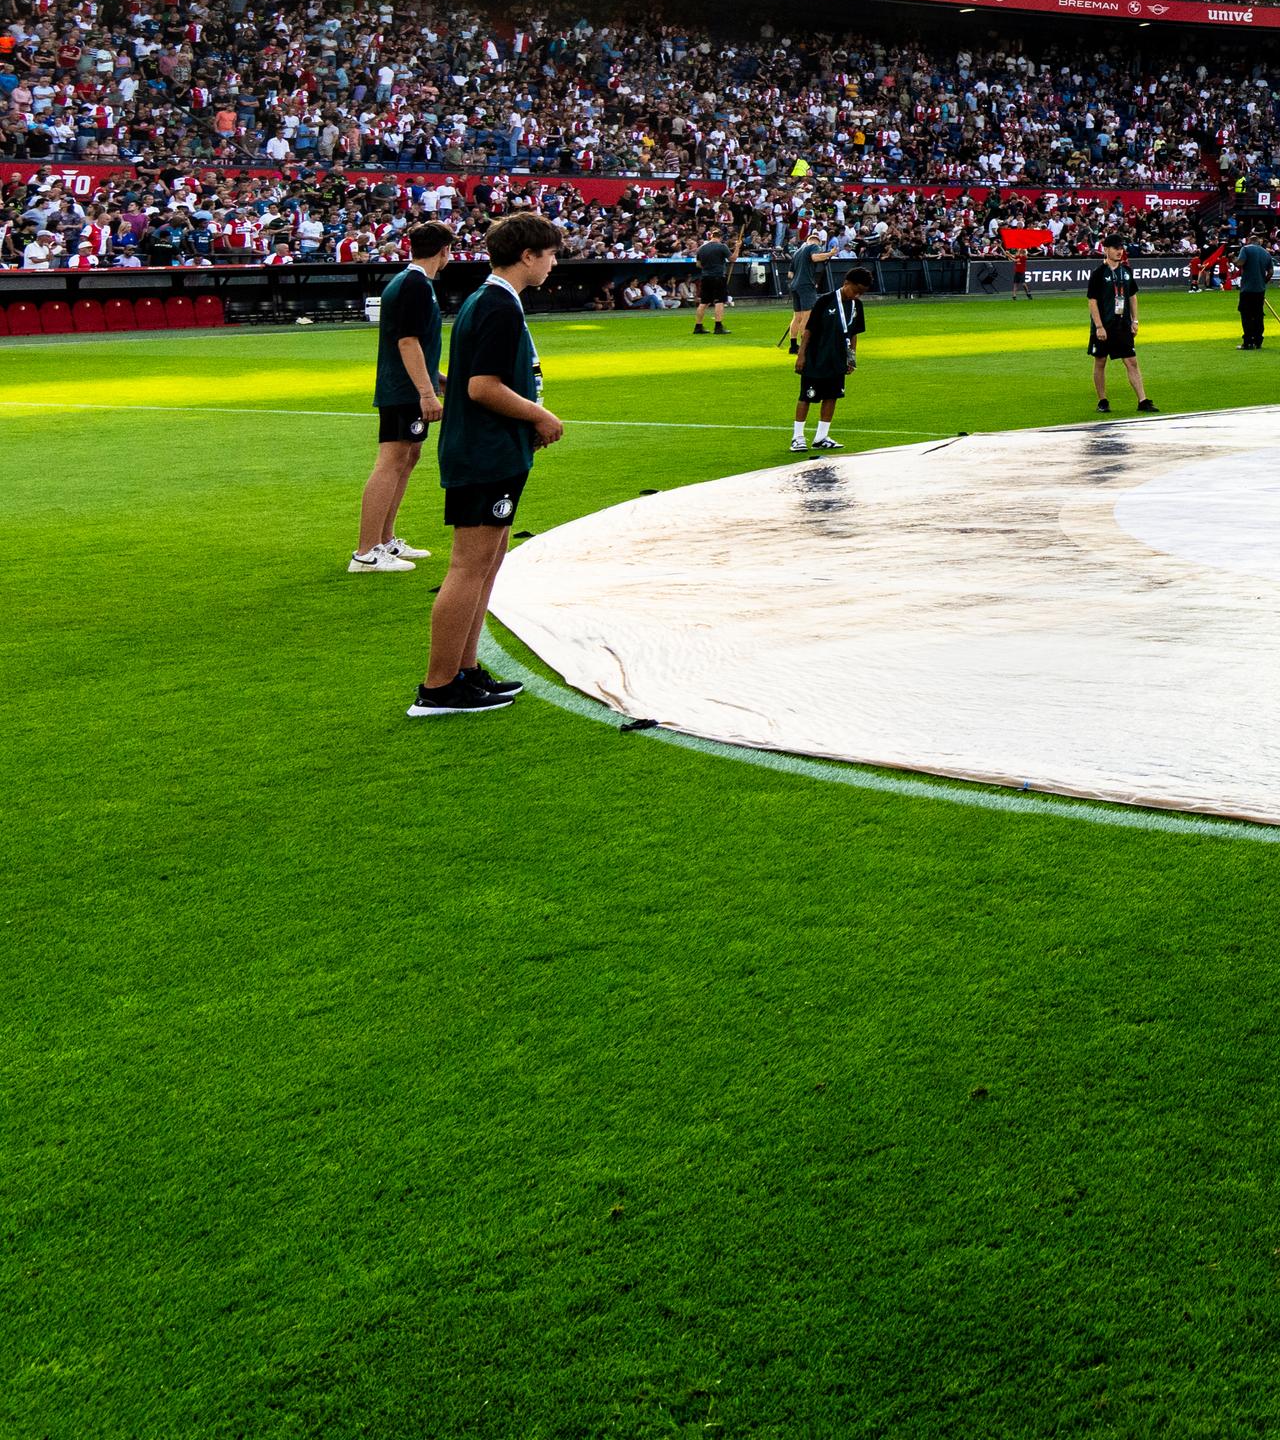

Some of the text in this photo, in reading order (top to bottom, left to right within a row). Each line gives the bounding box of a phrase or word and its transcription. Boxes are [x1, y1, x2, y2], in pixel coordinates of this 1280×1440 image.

[1207, 8, 1254, 23] univé
[1025, 270, 1073, 283] STERK
[1077, 269, 1091, 281] IN
